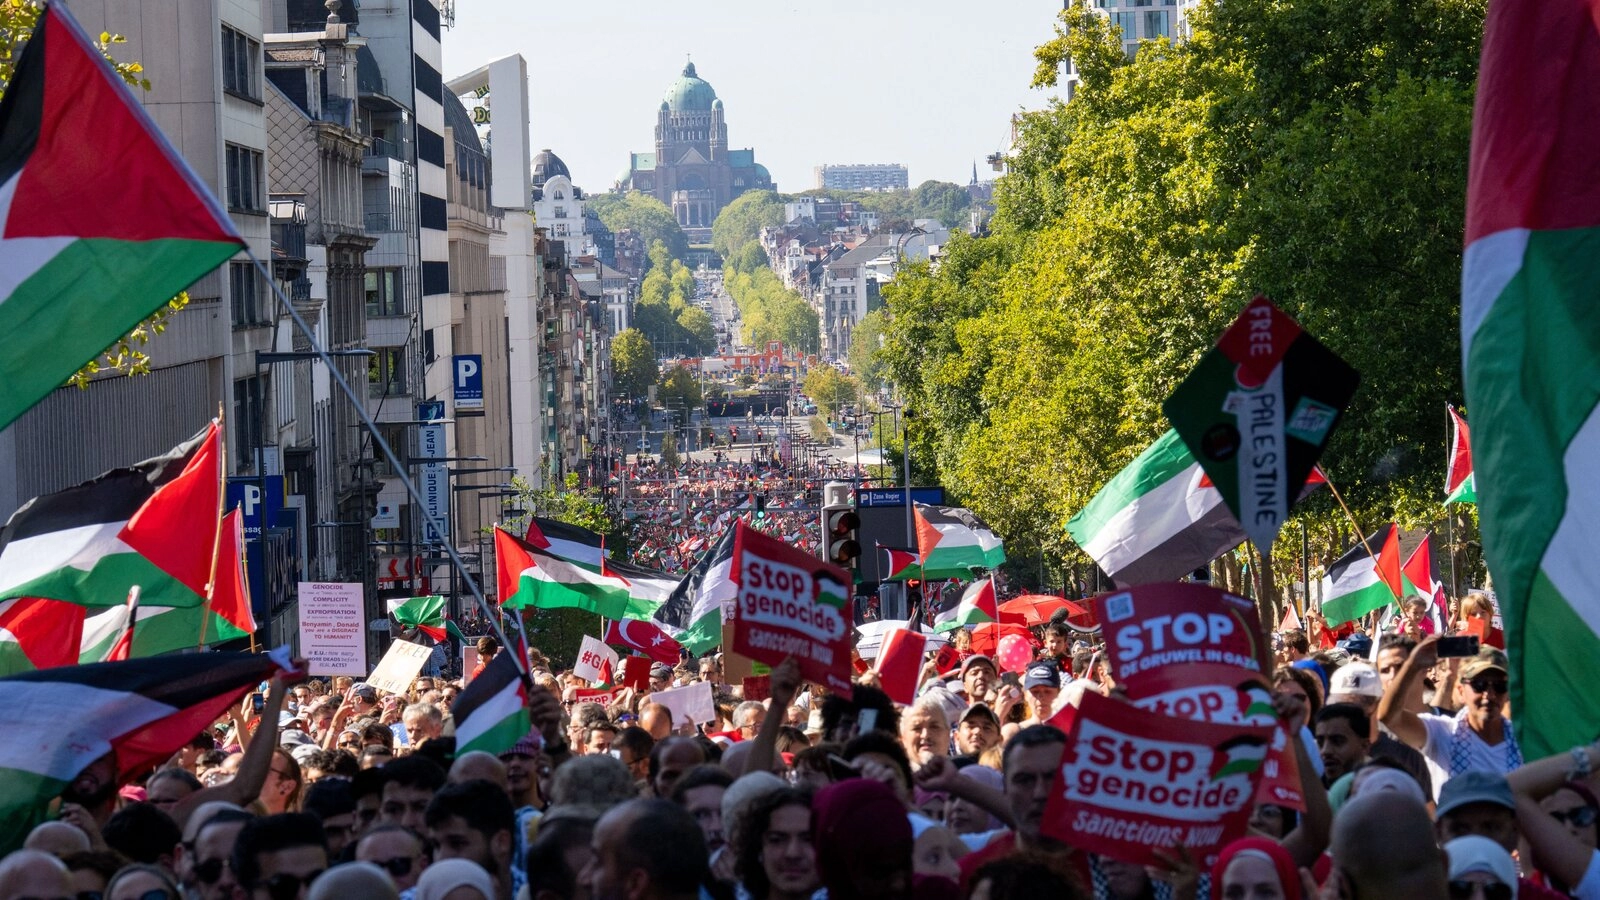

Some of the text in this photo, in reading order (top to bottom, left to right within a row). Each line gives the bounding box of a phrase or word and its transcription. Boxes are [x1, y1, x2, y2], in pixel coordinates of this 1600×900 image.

[1249, 305, 1272, 356] FREE
[458, 360, 478, 387] P
[1251, 394, 1277, 526] PALESTINE
[428, 474, 437, 516] CLINIQUE
[861, 494, 868, 503] P
[748, 562, 804, 600] Stop
[746, 592, 835, 633] genocide
[1116, 612, 1234, 661] STOP
[1120, 650, 1260, 680] DE GRUWEL IN GAZA
[1143, 692, 1223, 722] top
[1089, 735, 1195, 782] Stop
[1078, 768, 1239, 808] genocide
